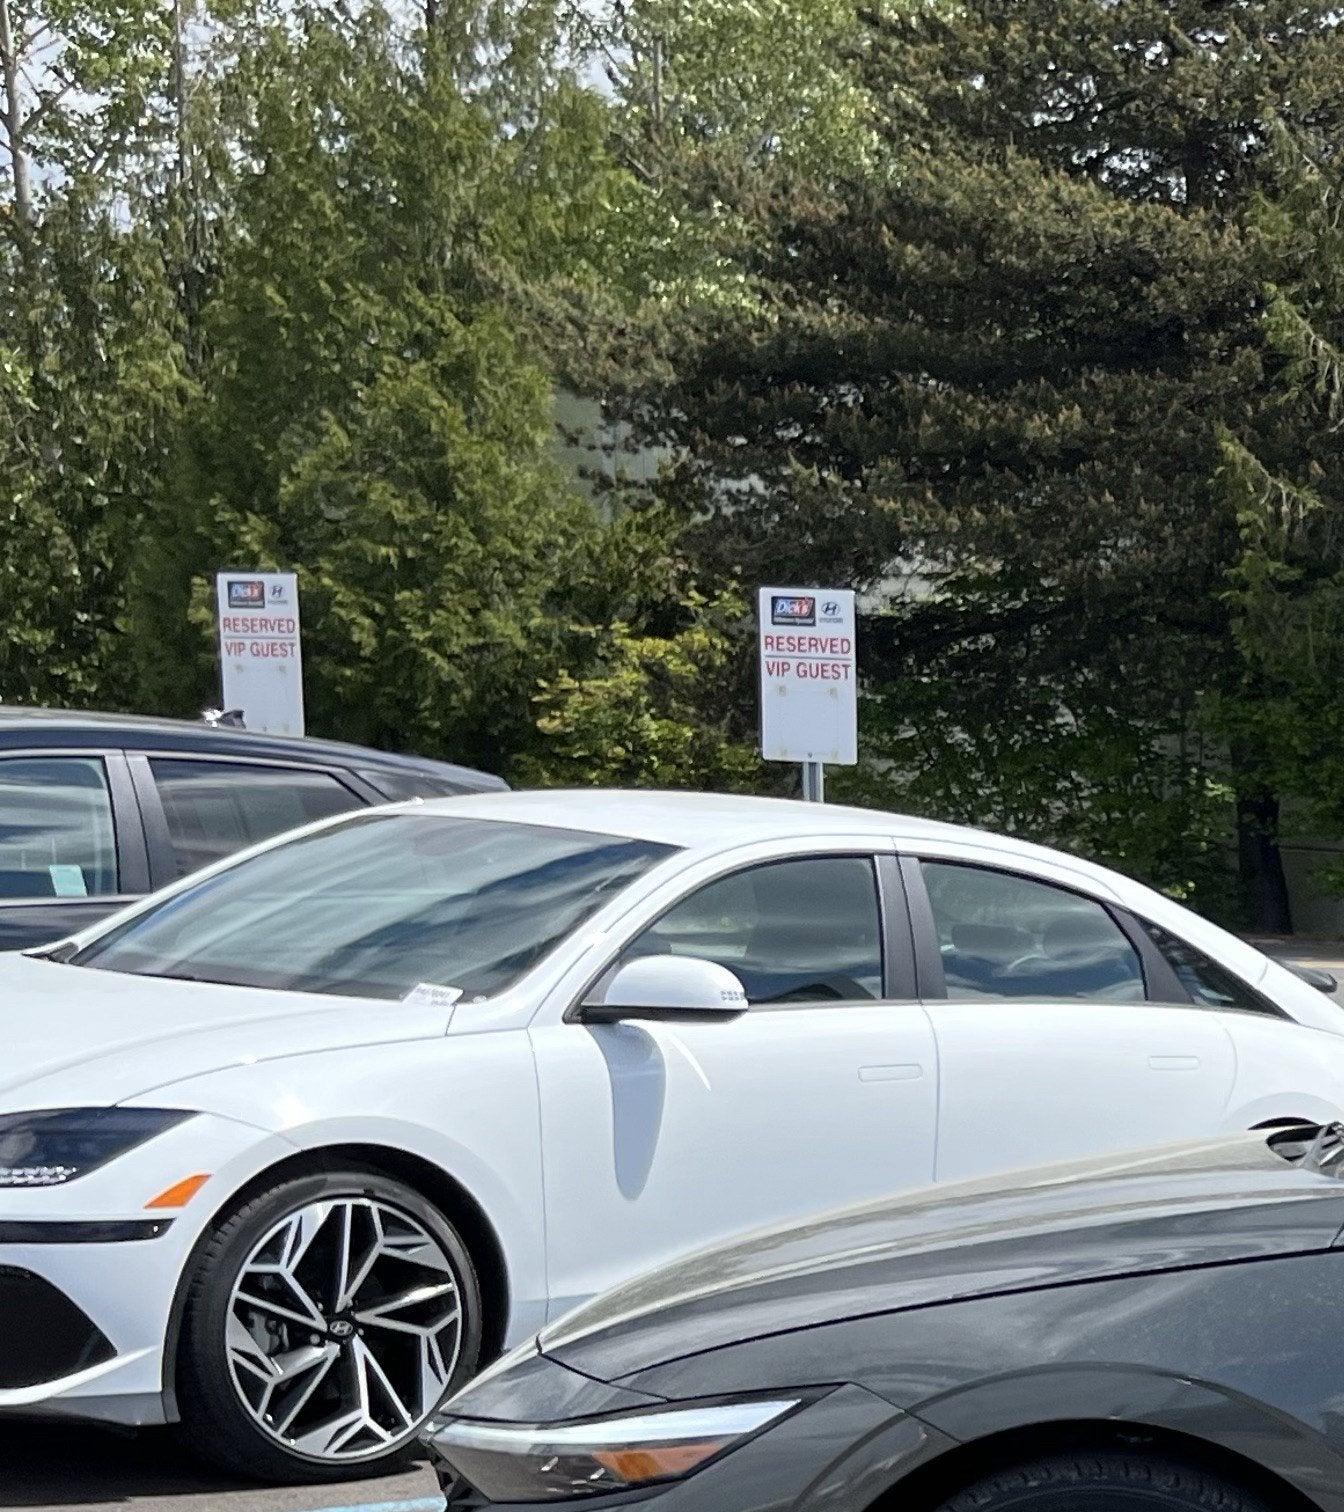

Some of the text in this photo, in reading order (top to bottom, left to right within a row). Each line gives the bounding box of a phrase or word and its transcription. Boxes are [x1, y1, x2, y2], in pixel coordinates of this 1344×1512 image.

[222, 616, 296, 634] RESERVED
[225, 641, 296, 658] VIP GUEST
[764, 634, 851, 655] RESERVED
[765, 660, 851, 680] VIP GUEST
